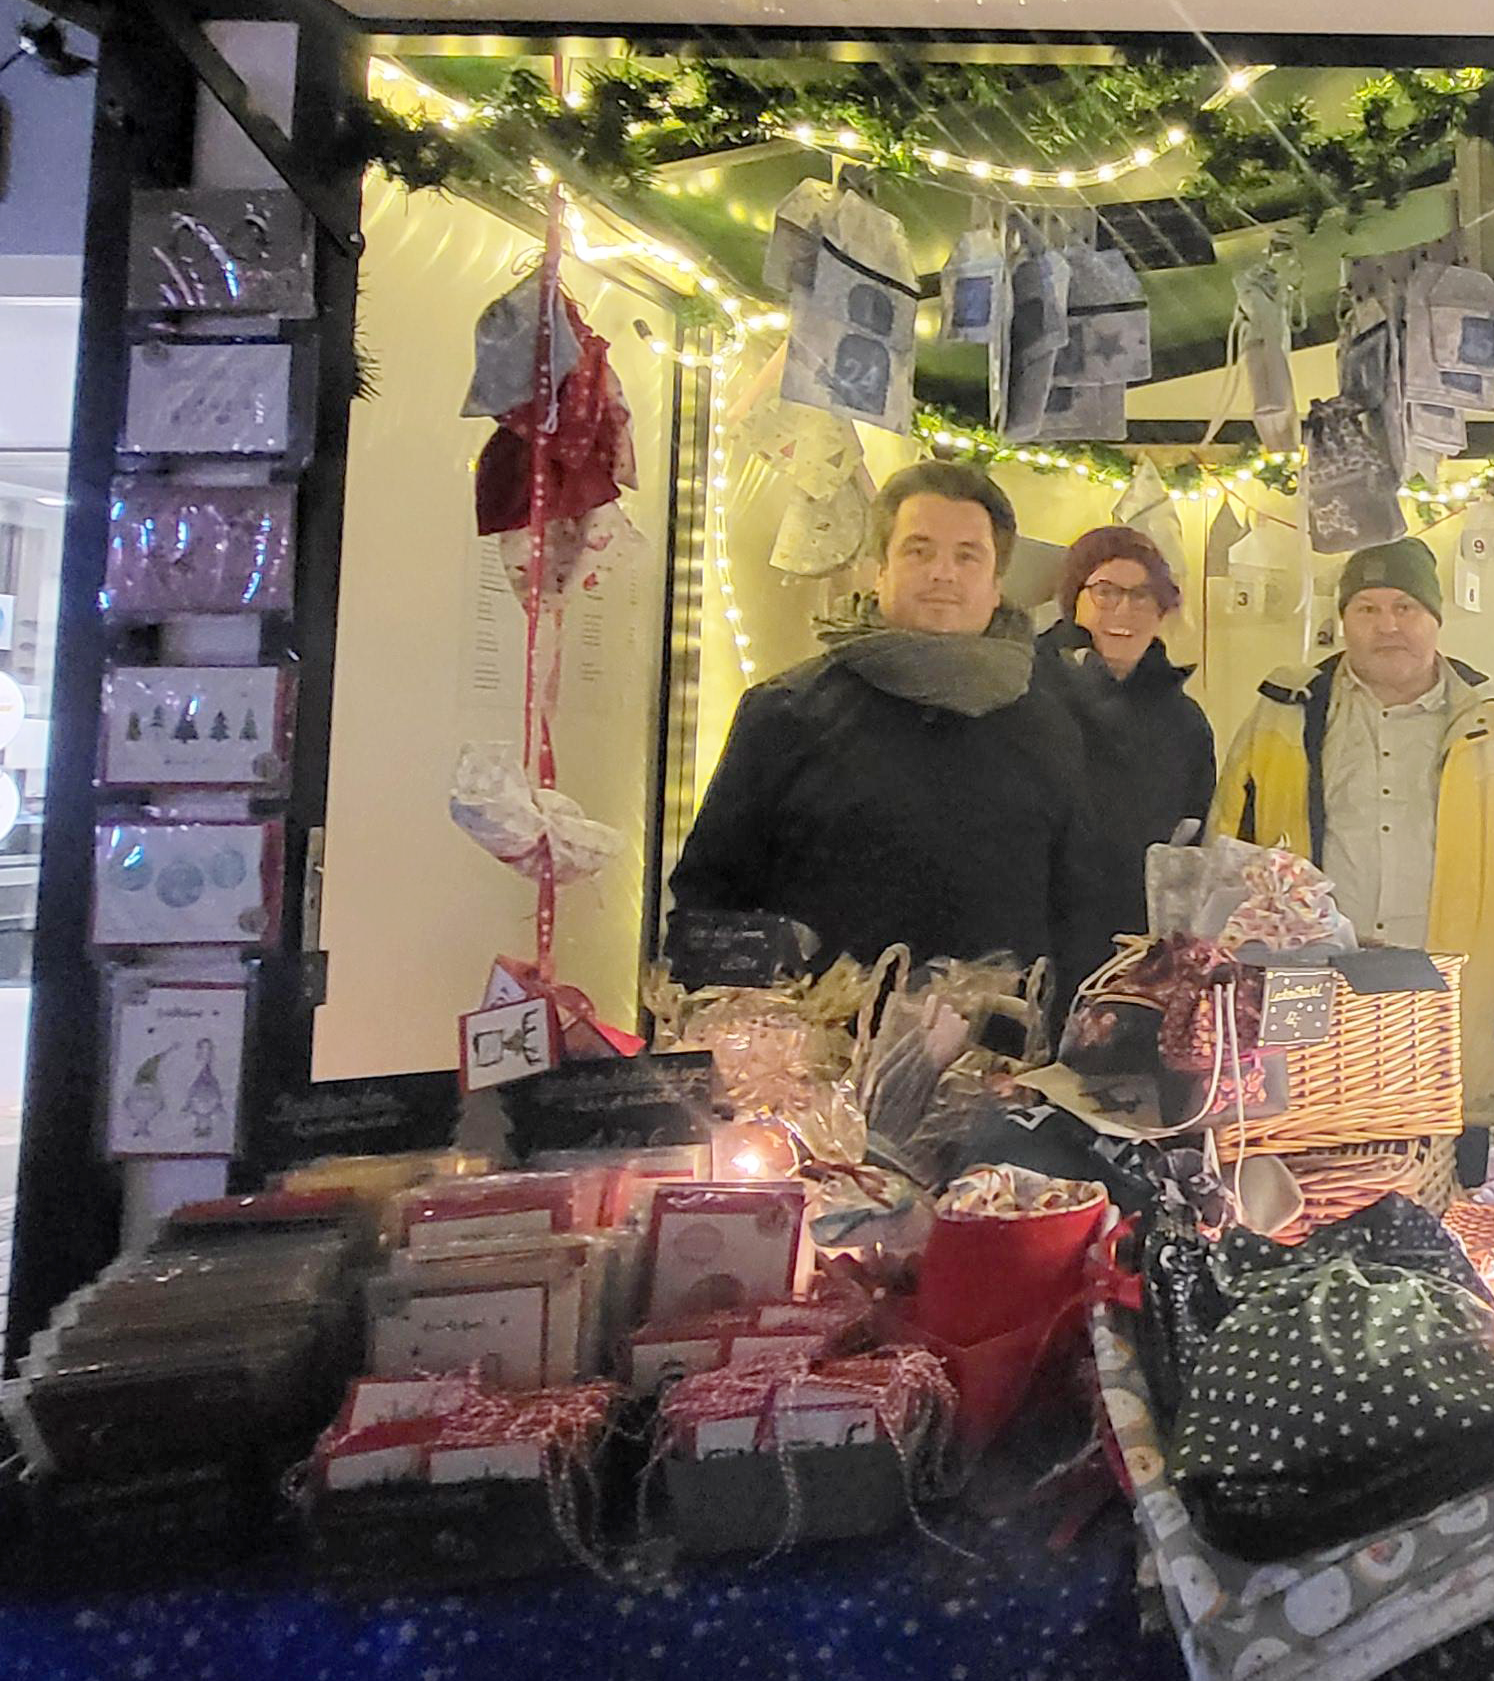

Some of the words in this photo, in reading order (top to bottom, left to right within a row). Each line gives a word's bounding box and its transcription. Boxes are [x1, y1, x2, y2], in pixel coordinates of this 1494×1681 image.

[843, 356, 879, 388] 24
[1473, 539, 1485, 554] 9
[1237, 591, 1249, 606] 3
